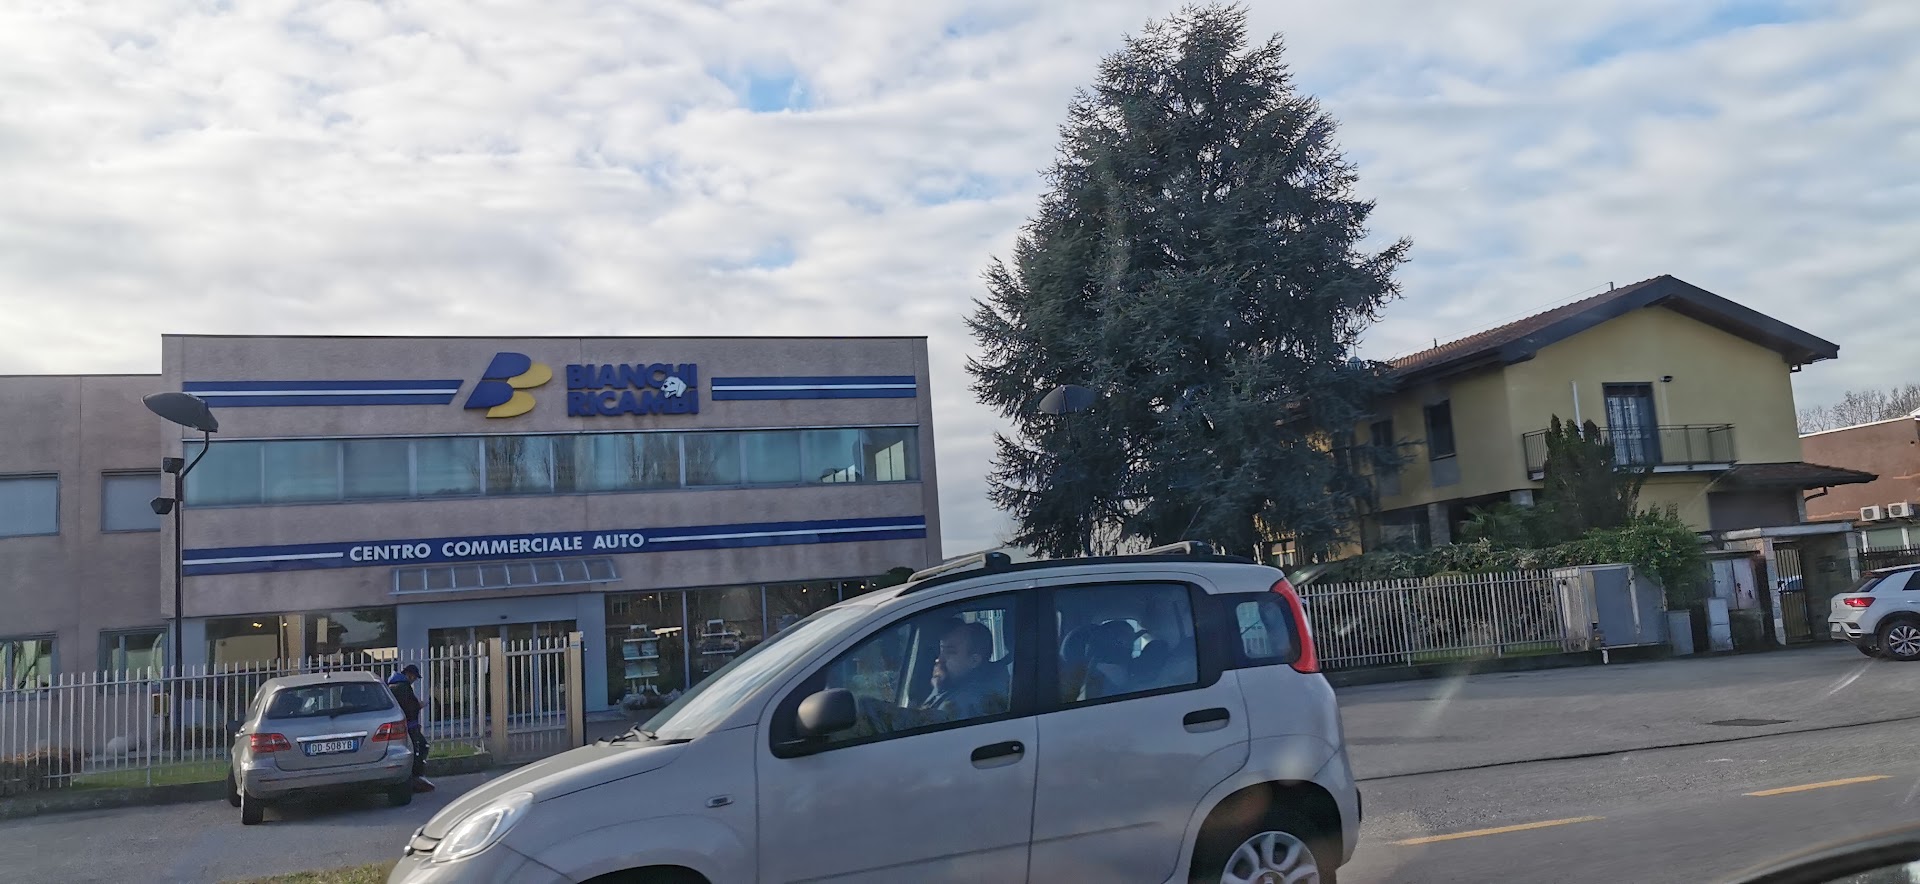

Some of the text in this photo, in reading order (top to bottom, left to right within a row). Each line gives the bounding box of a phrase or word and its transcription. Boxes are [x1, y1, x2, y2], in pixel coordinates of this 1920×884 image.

[566, 363, 698, 389] BIANCHI
[567, 390, 699, 417] RICAMBI
[350, 533, 645, 562] CENTRO COMMERCIALE AUTO
